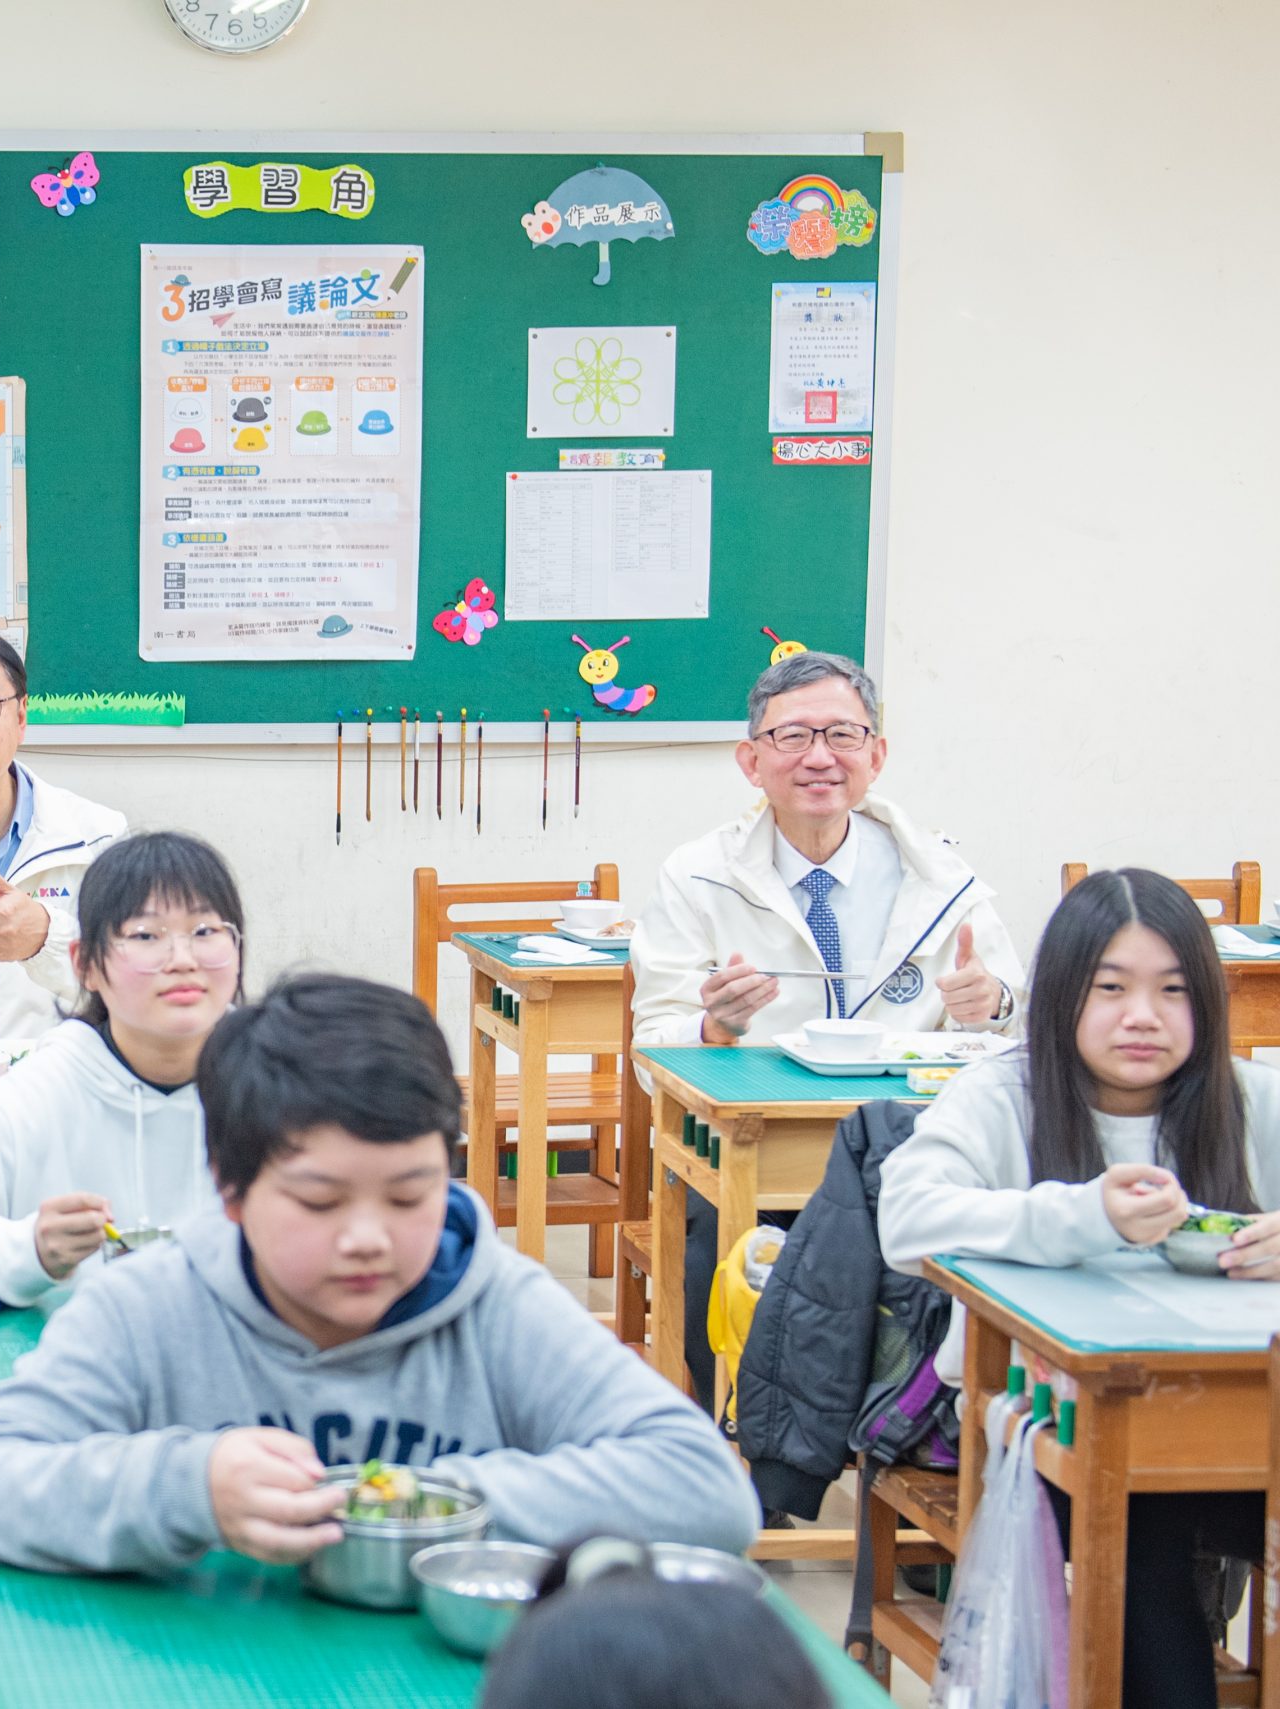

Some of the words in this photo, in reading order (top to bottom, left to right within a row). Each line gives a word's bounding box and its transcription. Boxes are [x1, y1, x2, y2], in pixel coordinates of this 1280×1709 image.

[205, 13, 218, 31] 7
[227, 19, 243, 36] 6
[252, 12, 267, 30] 5
[192, 167, 366, 210] 學習角
[566, 203, 662, 226] 作品展示
[756, 204, 868, 255] 榮譽榜
[570, 453, 657, 466] 讀報教育
[27, 887, 70, 897] AKKA
